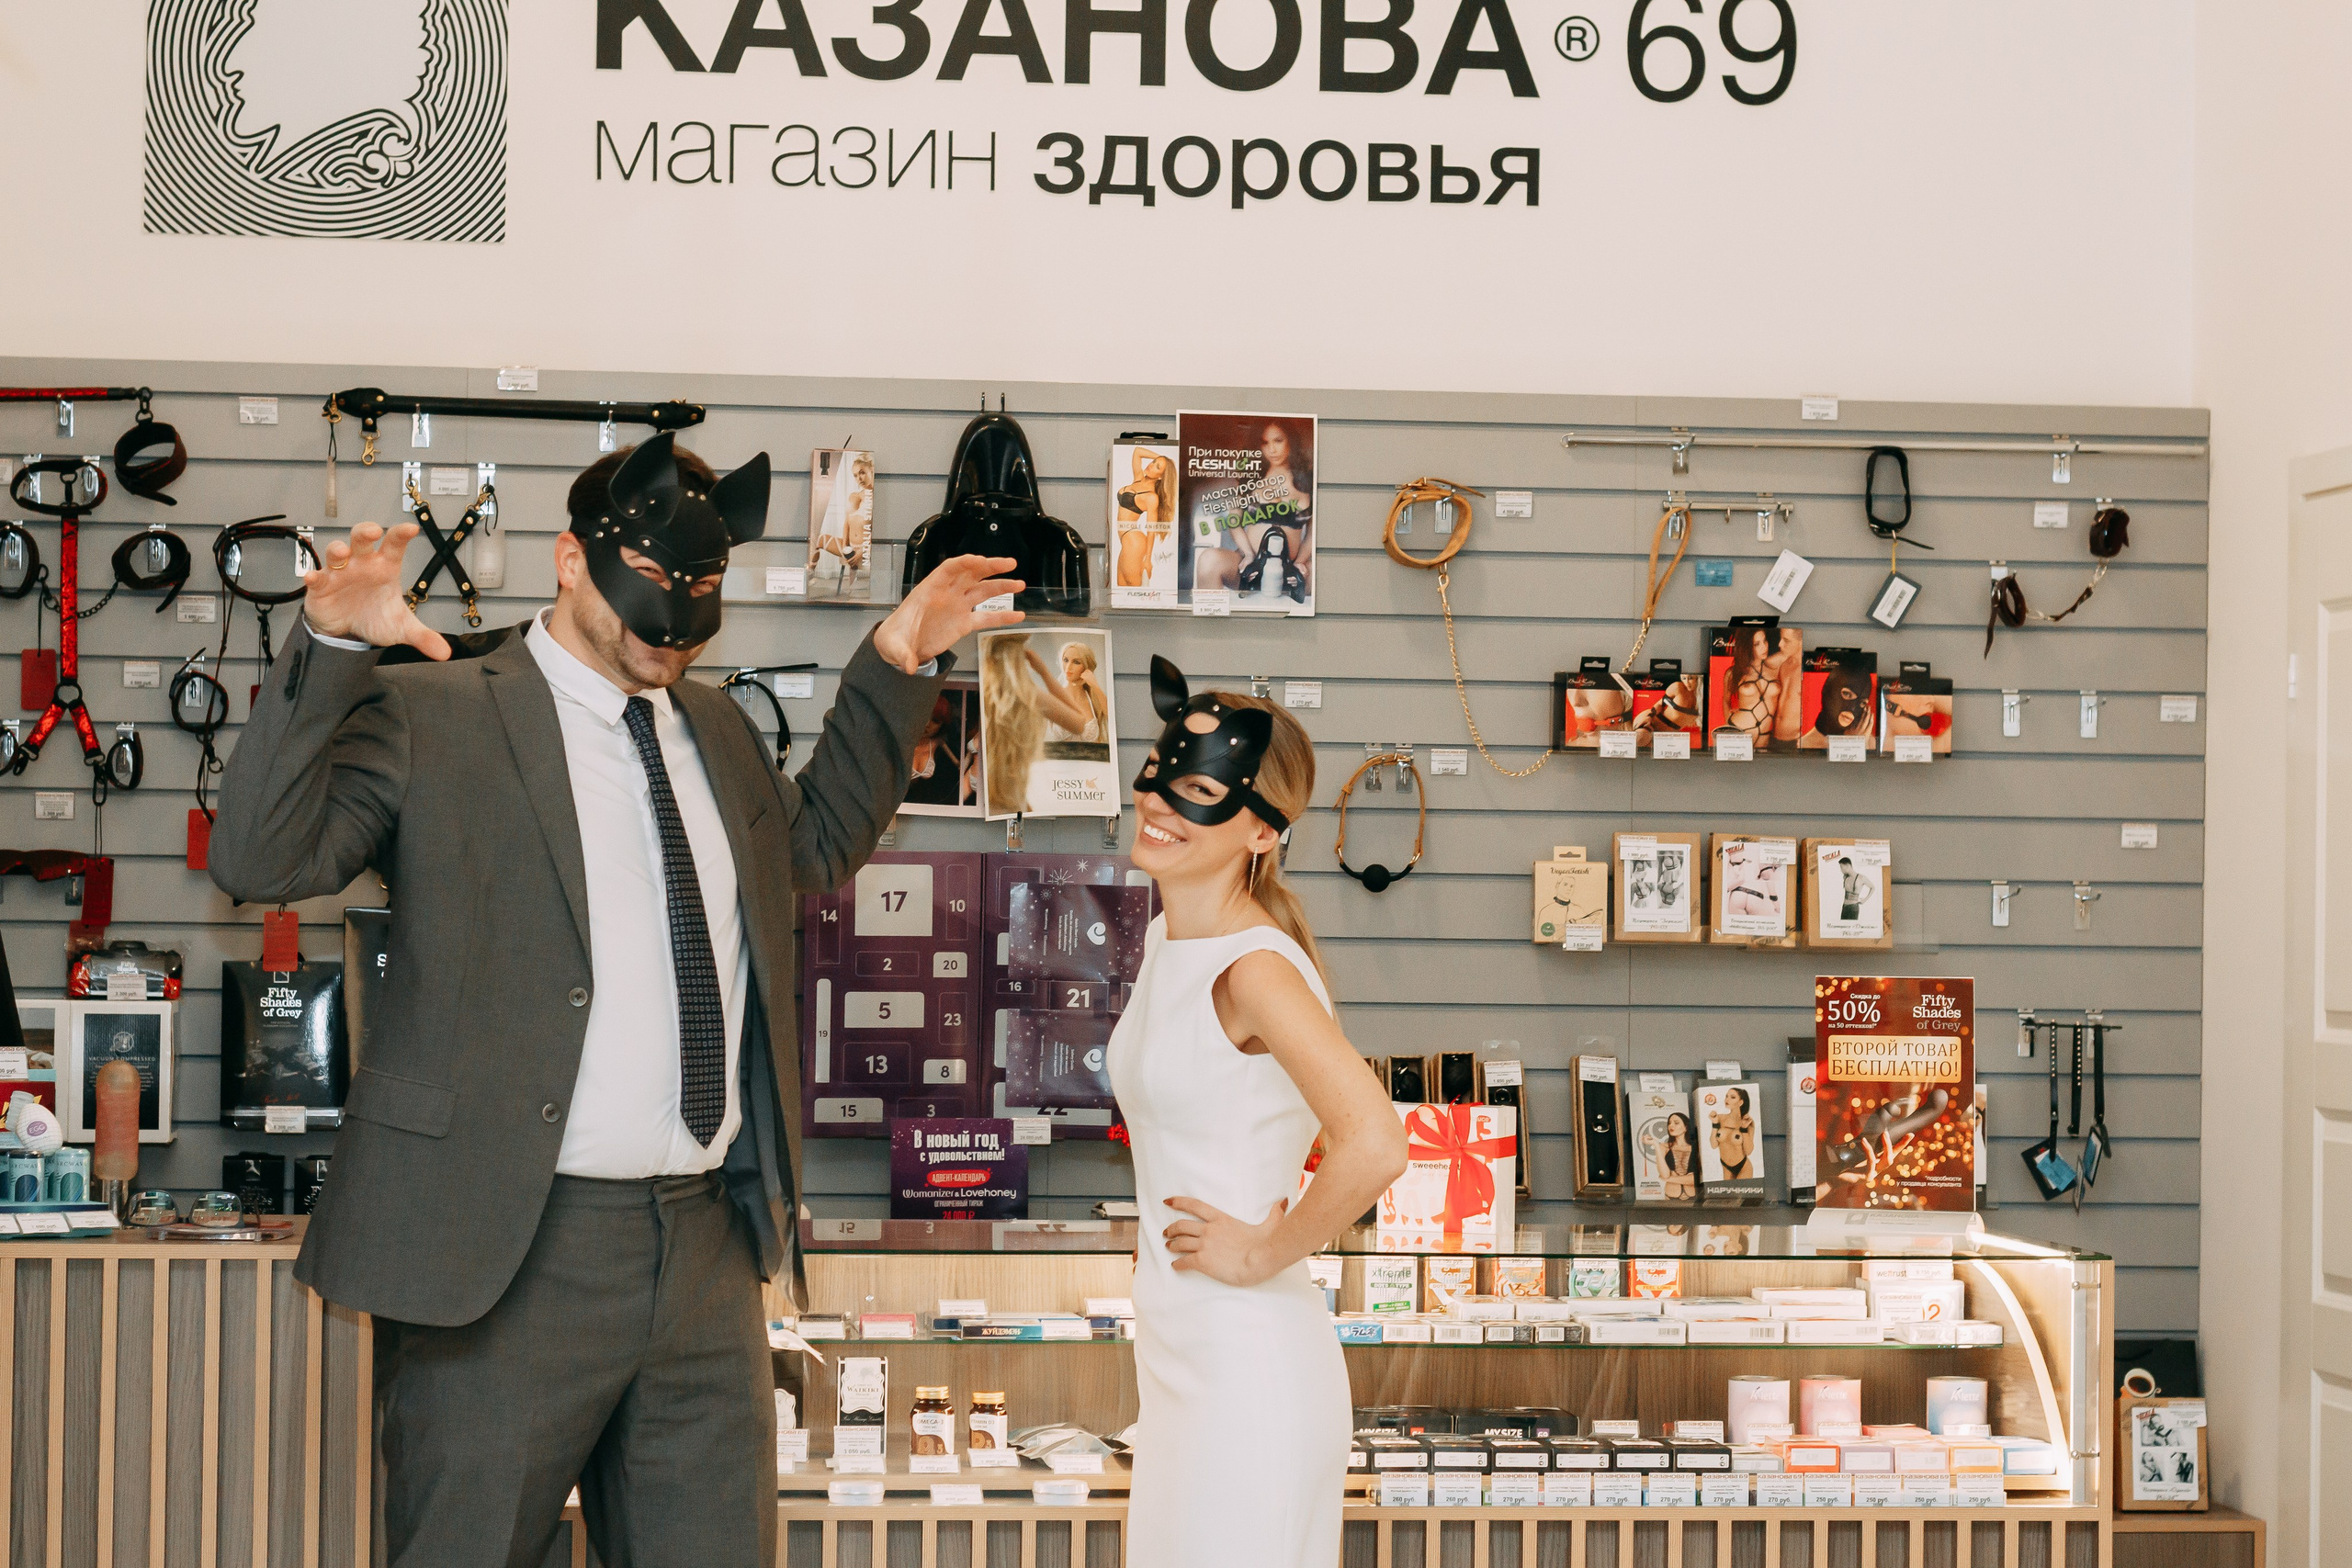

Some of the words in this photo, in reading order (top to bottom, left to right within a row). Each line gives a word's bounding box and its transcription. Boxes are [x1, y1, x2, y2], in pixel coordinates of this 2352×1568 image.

[595, 0, 1540, 97] КАЗАНОВА
[1626, 0, 1798, 105] 69
[596, 119, 996, 191] магазин
[1034, 131, 1540, 209] здоровья
[1188, 446, 1213, 458] При
[1215, 449, 1261, 459] покупке
[1202, 474, 1285, 502] мастурбатор
[1203, 492, 1260, 516] Fleshlight
[1262, 485, 1289, 502] Girls
[1199, 521, 1211, 536] В
[1214, 499, 1303, 533] ПОДАРОК
[862, 524, 872, 567] NATALIA
[880, 891, 908, 912] 17
[949, 899, 966, 912] 10
[820, 909, 838, 922] 14
[883, 958, 892, 971] 2
[943, 960, 958, 970] 20
[267, 987, 298, 999] Fifty
[1008, 982, 1022, 992] 16
[260, 997, 302, 1008] Shades
[1067, 988, 1090, 1008] 21
[1921, 994, 1956, 1009] Fifty
[263, 1008, 275, 1017] of
[276, 1008, 303, 1019] Grey
[878, 1002, 891, 1020] 5
[1828, 1000, 1881, 1022] 50%
[1913, 1006, 1962, 1019] Shades
[944, 1013, 962, 1026] 23
[1917, 1020, 1929, 1030] of
[1932, 1021, 1962, 1032] Grey
[1833, 1040, 1898, 1056] ВТОРОЙ
[1904, 1043, 1958, 1056] ТОВАР
[865, 1055, 888, 1074] 13
[1832, 1059, 1958, 1077] БЕСПЛАТНО!
[940, 1066, 950, 1078] 8
[841, 1105, 857, 1117] 15
[927, 1105, 935, 1117] 3
[29, 1124, 45, 1134] EGG
[913, 1130, 922, 1148] В
[926, 1130, 970, 1148] новый
[975, 1134, 1000, 1150] год
[920, 1154, 926, 1162] с
[928, 1147, 1005, 1165] удовольствием!
[932, 1172, 986, 1183] АДВЕНТ-КАЛЕНДАРЬ
[902, 1189, 954, 1198] Womanizer
[961, 1189, 1017, 1199] Lovehoney
[1707, 1187, 1764, 1195] НАРУЧНИКИ
